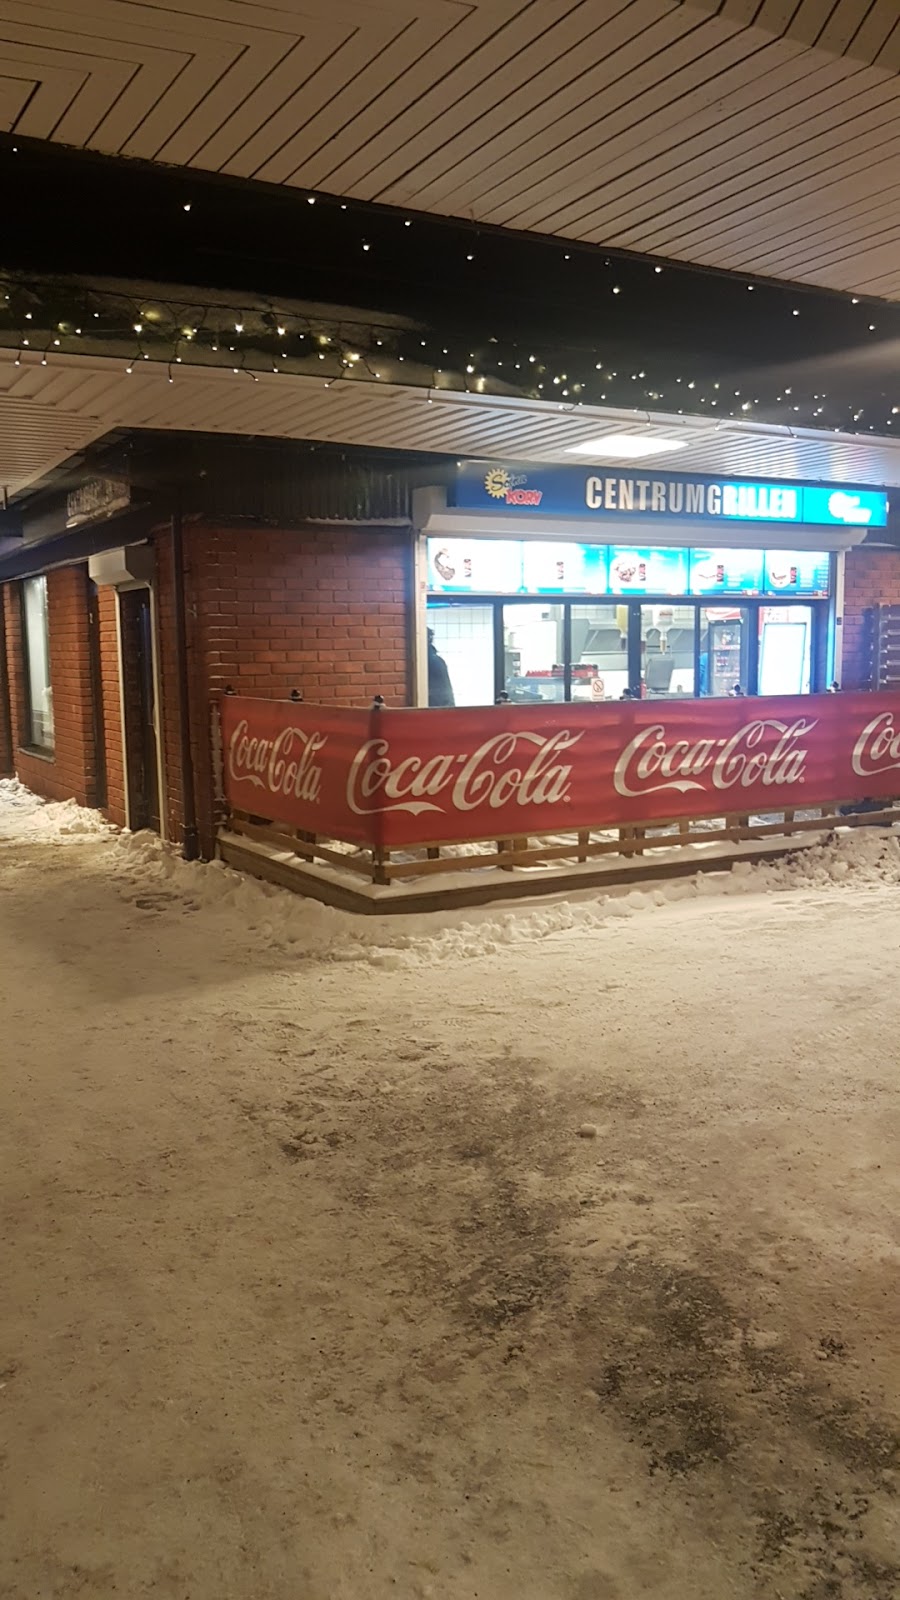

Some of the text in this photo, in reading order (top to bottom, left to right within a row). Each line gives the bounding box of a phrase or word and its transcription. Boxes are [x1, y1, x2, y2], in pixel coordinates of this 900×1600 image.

[229, 720, 328, 802] Coca-Cola
[347, 730, 586, 816] Coca-Cola
[613, 718, 819, 797] Coca-Cola
